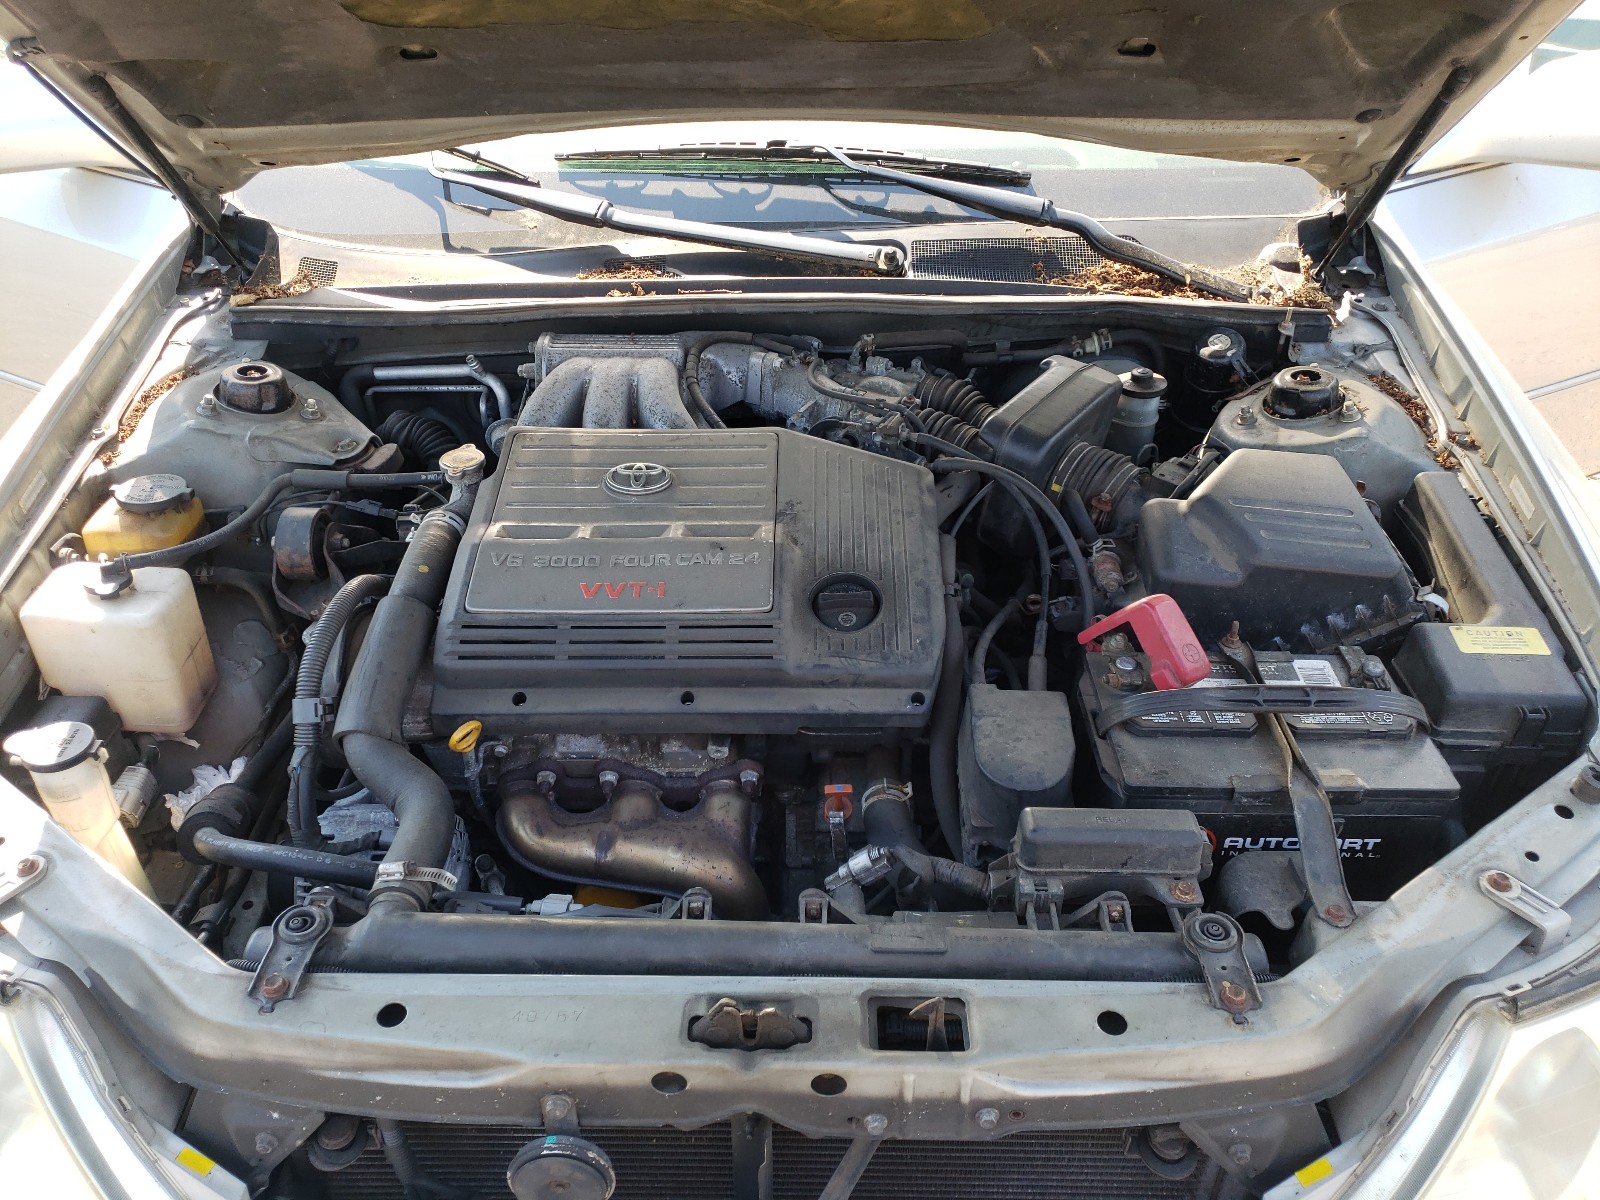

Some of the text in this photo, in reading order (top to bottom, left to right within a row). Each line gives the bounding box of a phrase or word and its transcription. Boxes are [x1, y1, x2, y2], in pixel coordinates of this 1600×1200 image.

[490, 551, 762, 568] V6 3000 FOUR CAM 24
[579, 581, 667, 599] VVT-i
[1466, 629, 1524, 637] CAUTION
[1095, 816, 1128, 825] RELAY
